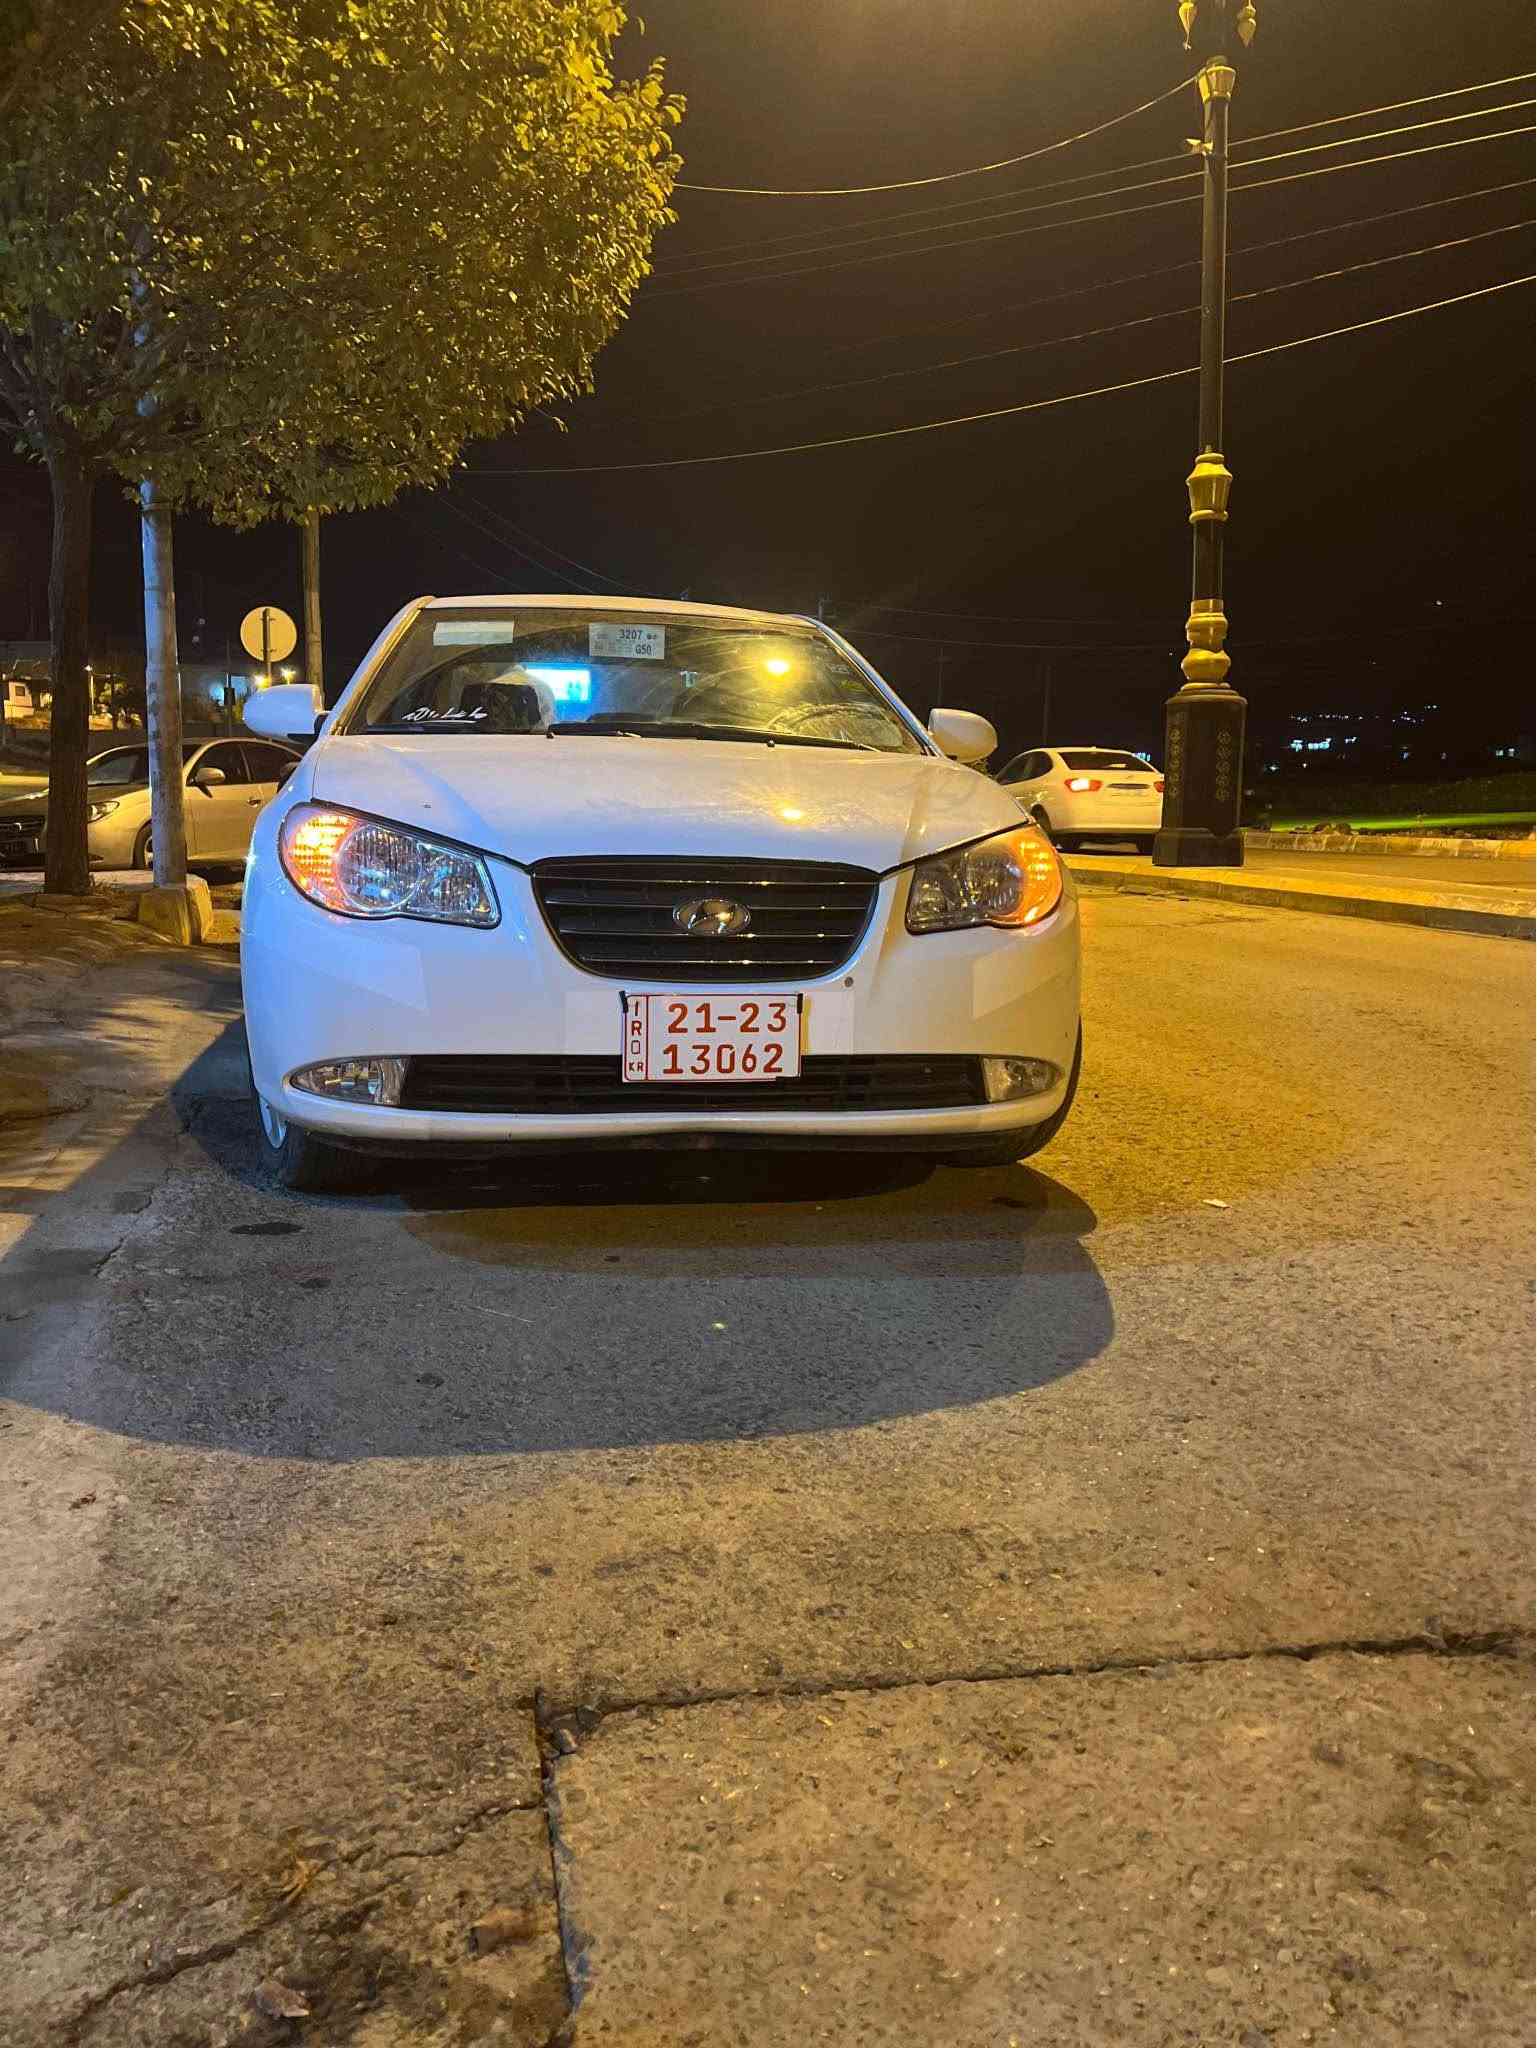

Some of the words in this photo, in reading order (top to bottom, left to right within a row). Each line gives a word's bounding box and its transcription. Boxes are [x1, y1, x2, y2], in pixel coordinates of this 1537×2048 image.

[667, 1002, 787, 1033] 21-23
[628, 1062, 644, 1072] KR
[662, 1043, 783, 1074] 13062
